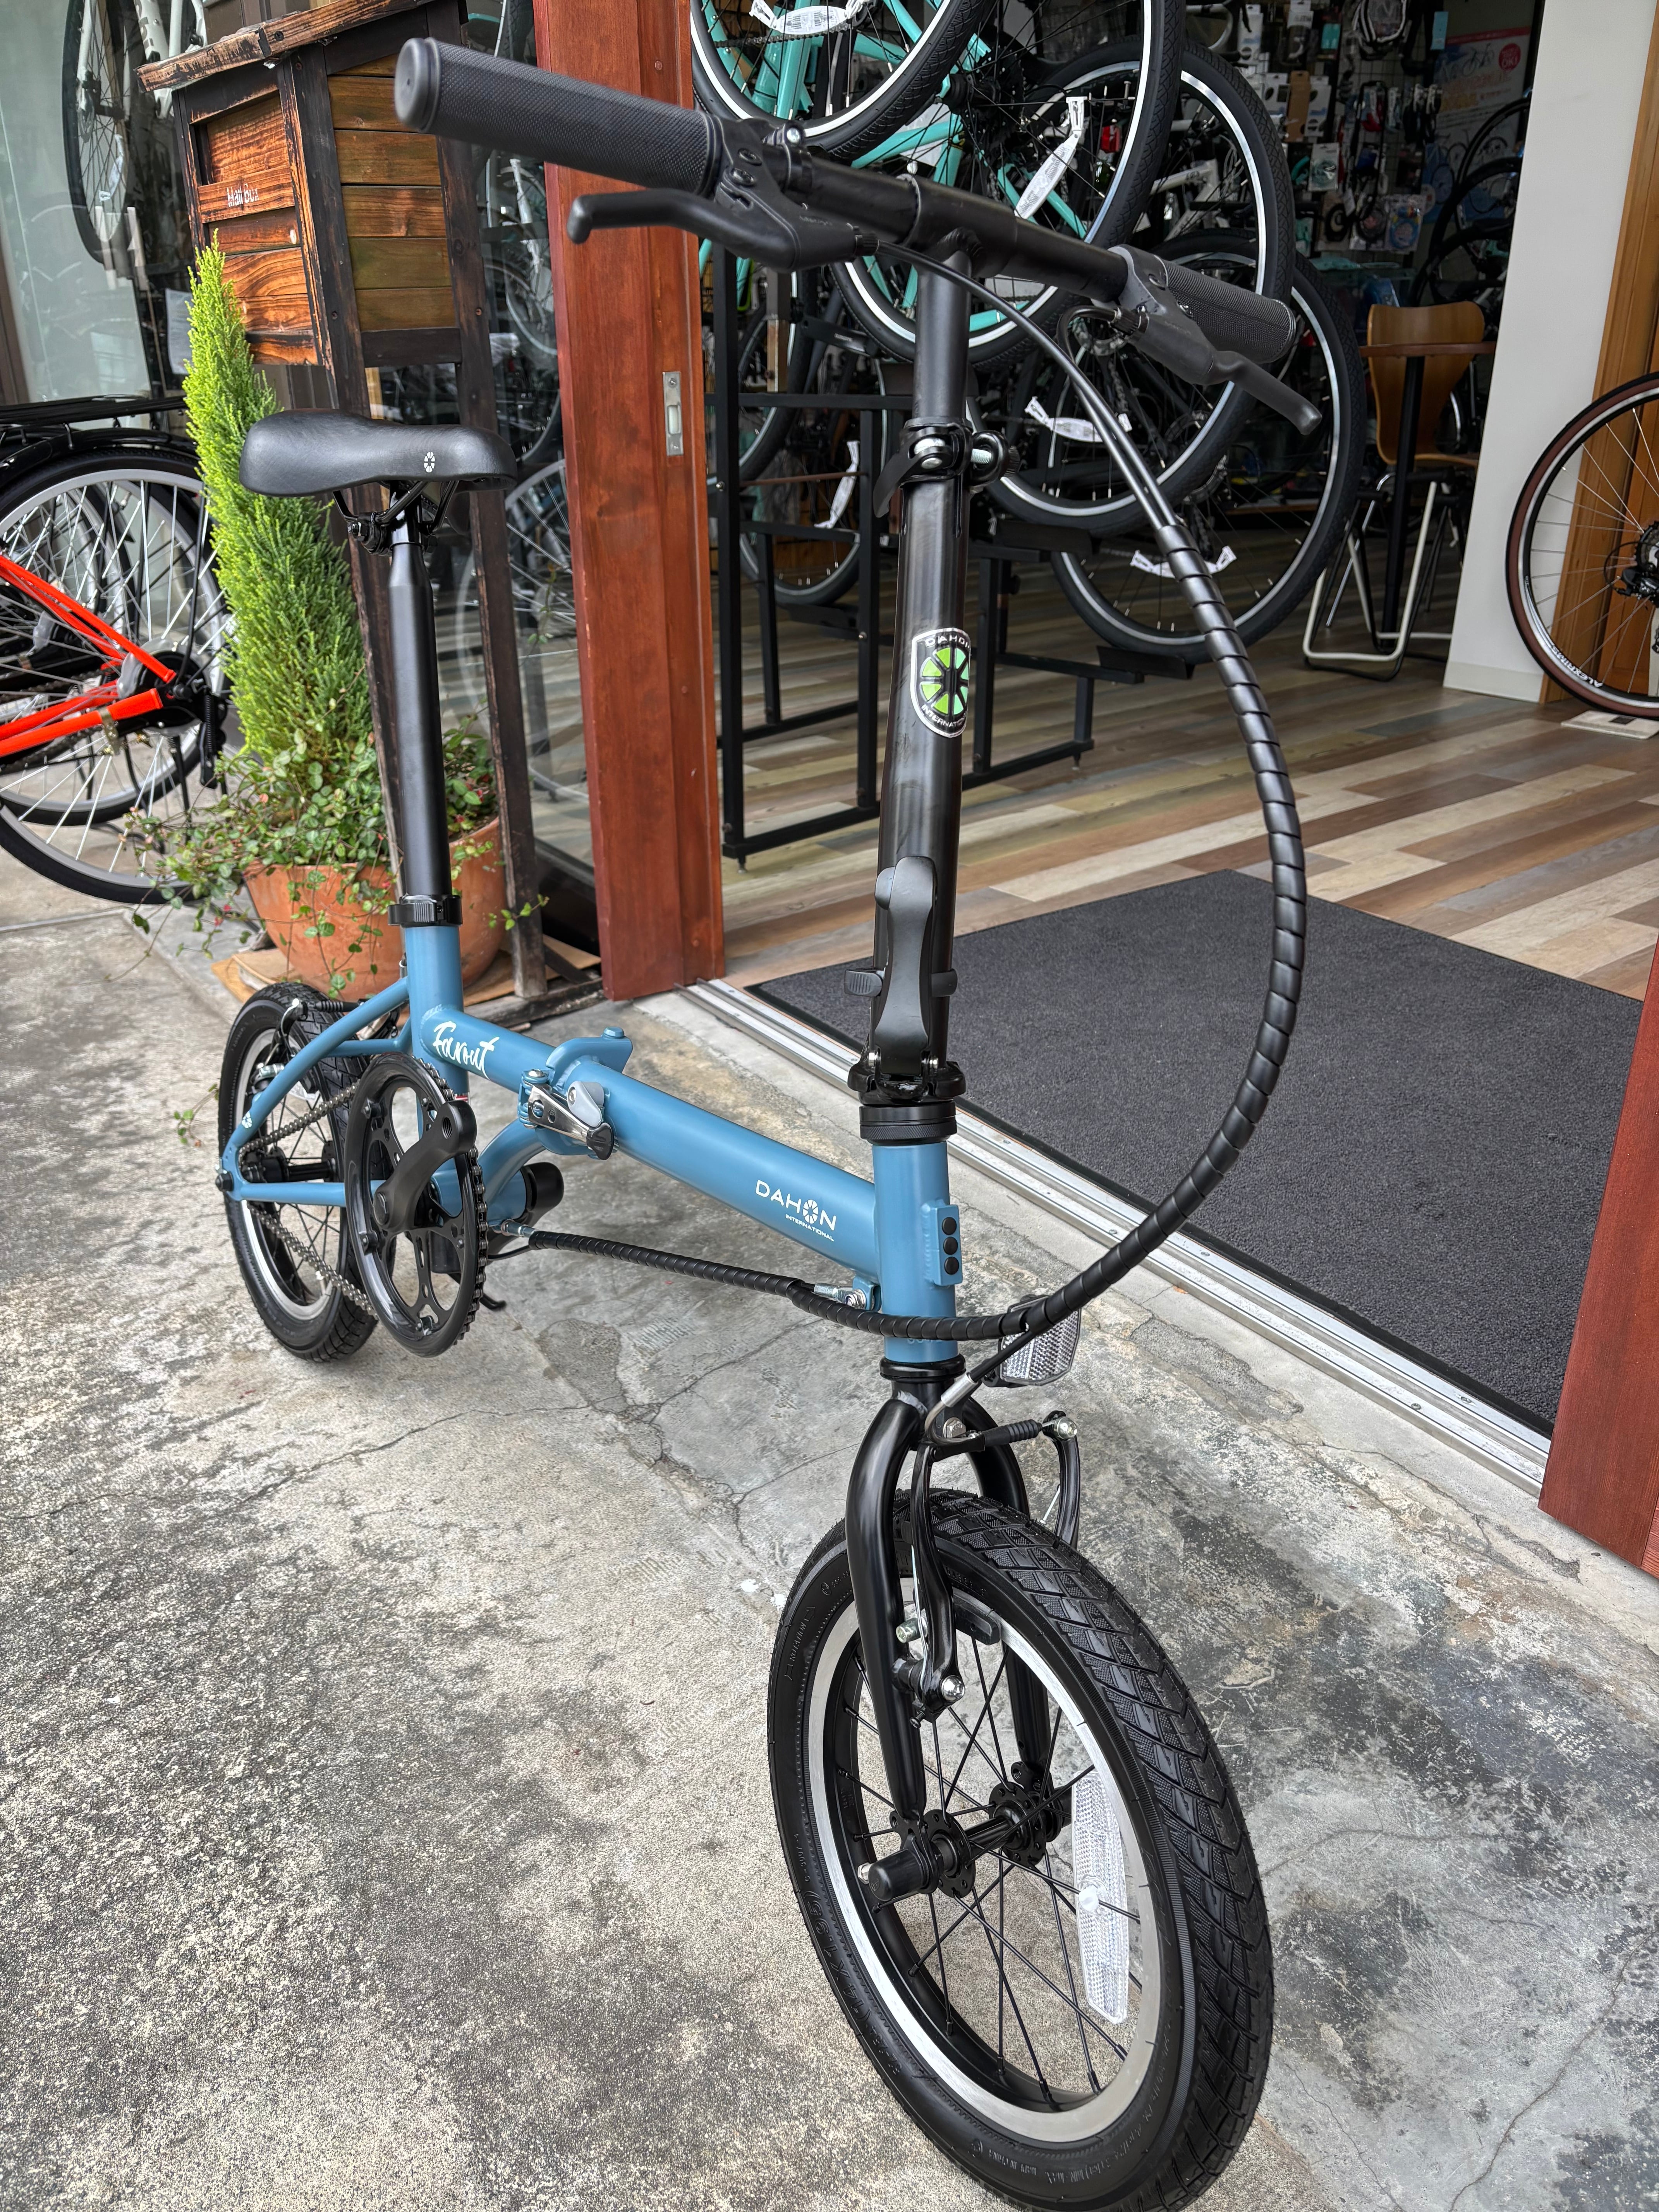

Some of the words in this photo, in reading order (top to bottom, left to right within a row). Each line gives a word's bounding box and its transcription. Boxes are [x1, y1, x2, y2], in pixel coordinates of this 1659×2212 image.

[433, 1020, 500, 1080] Farout
[756, 1180, 836, 1231] DAHON
[785, 1214, 834, 1242] INTERNATIONAL
[790, 1621, 807, 1662] ROTATION
